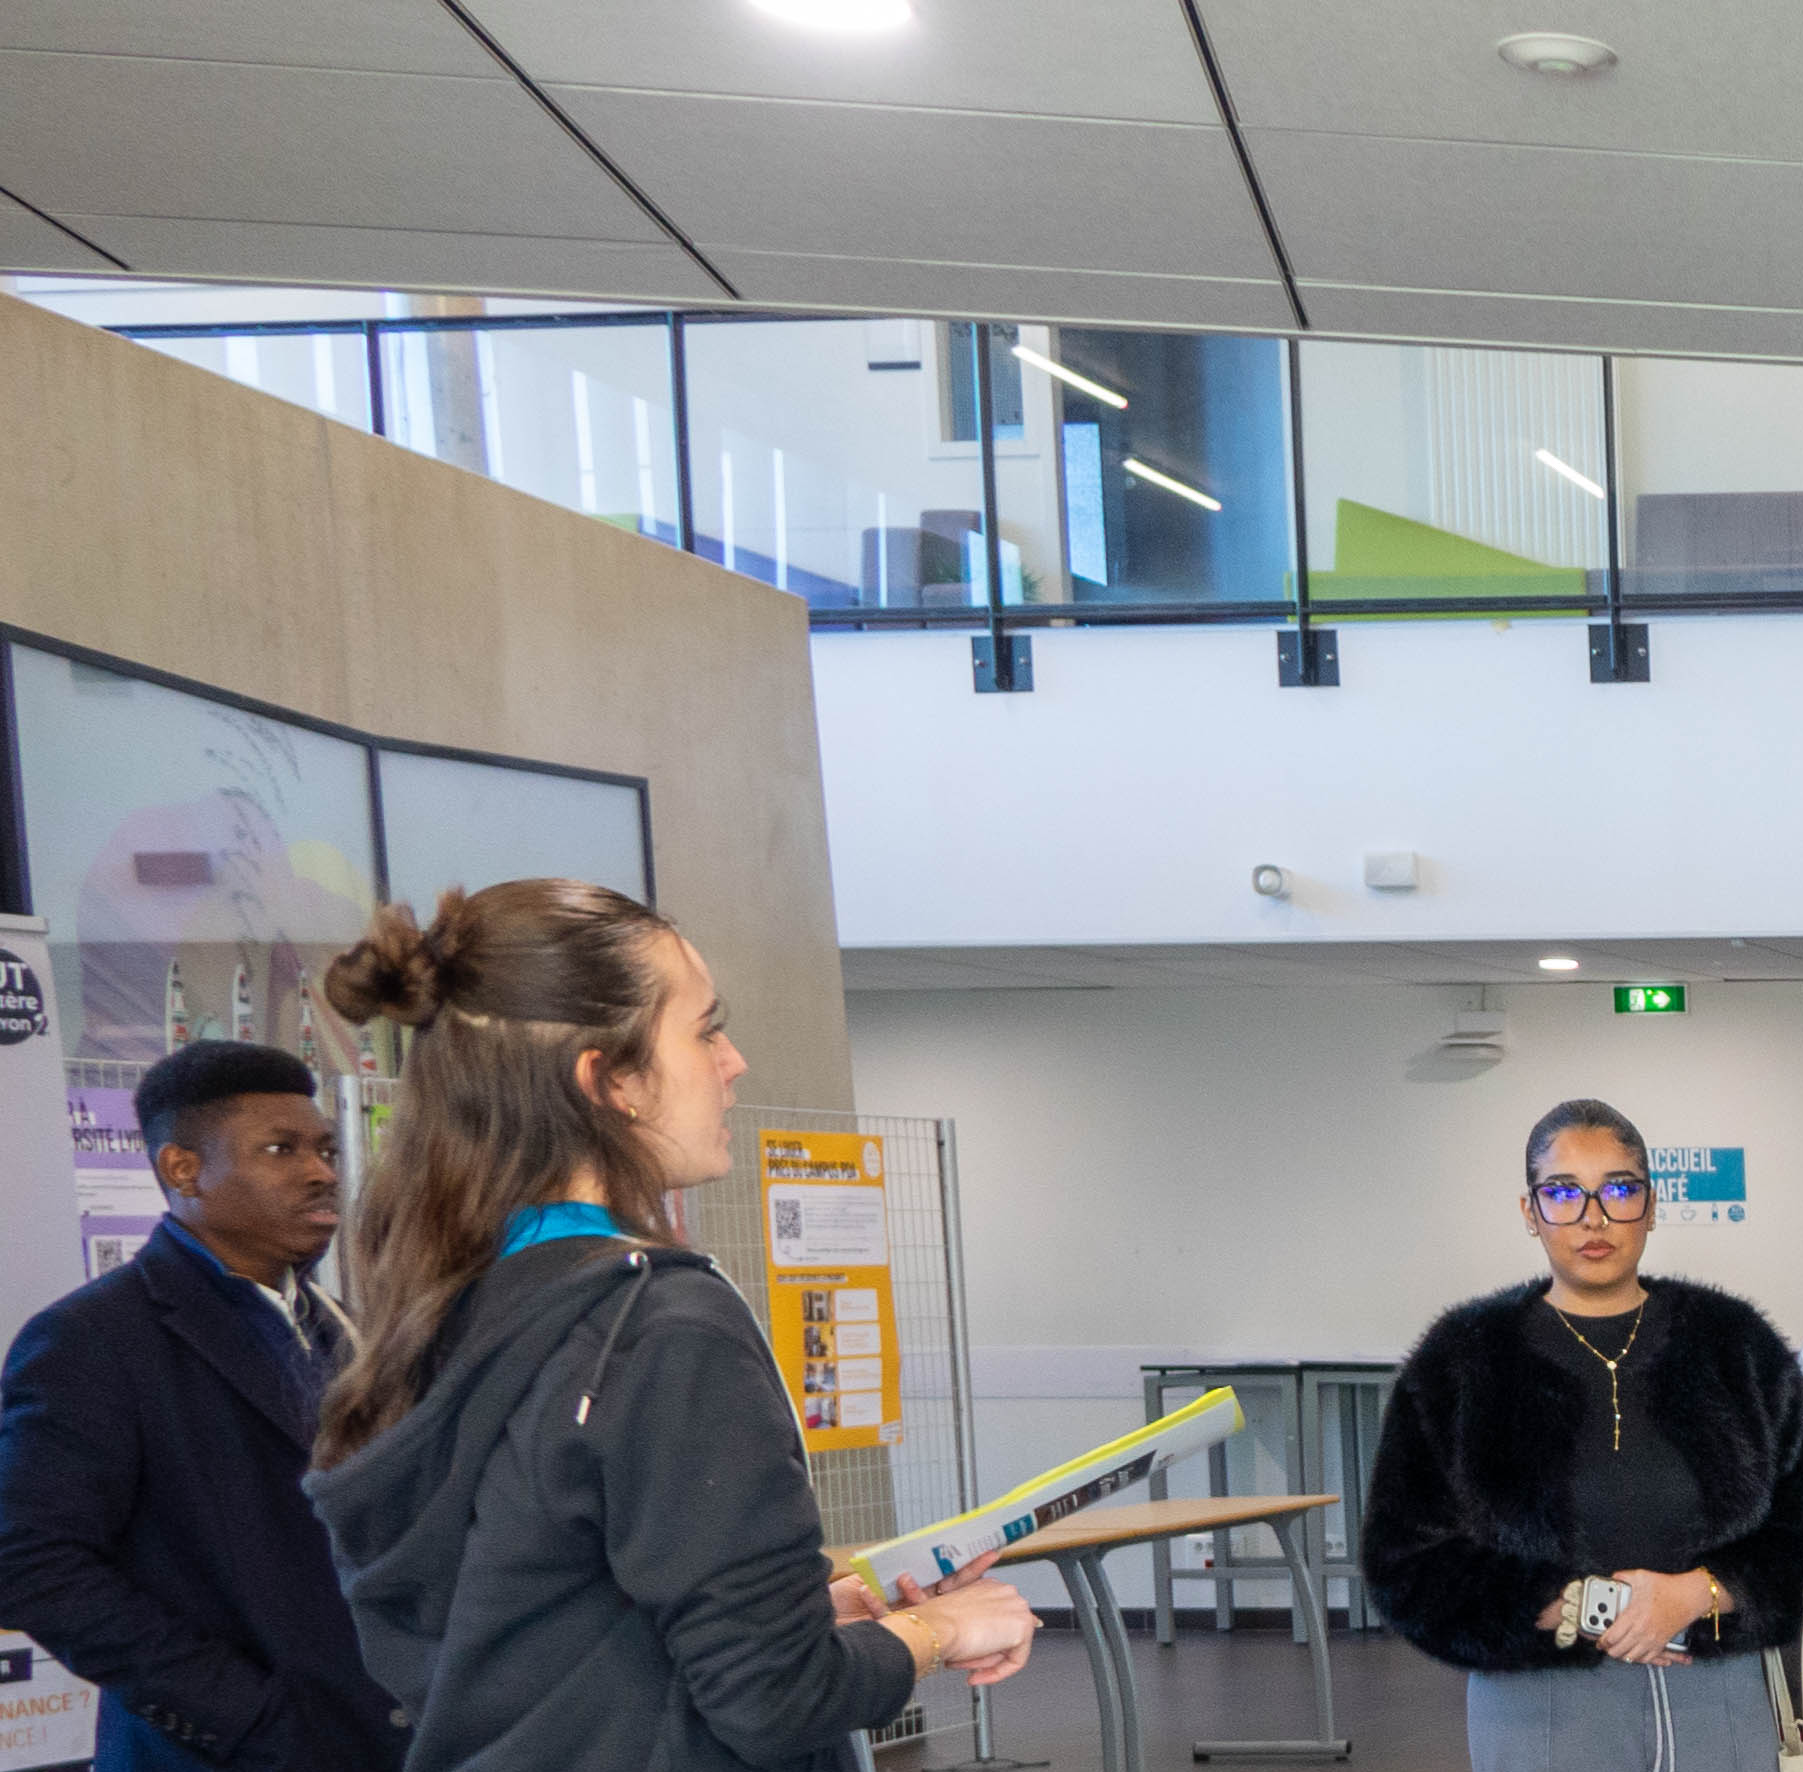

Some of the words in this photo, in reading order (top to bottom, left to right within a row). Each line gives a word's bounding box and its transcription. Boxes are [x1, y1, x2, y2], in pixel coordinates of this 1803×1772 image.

[0, 1017, 32, 1032] yon
[1648, 1148, 1717, 1172] ACCUEIL
[1651, 1174, 1689, 1201] AFÉ
[0, 1692, 73, 1720] NANCE
